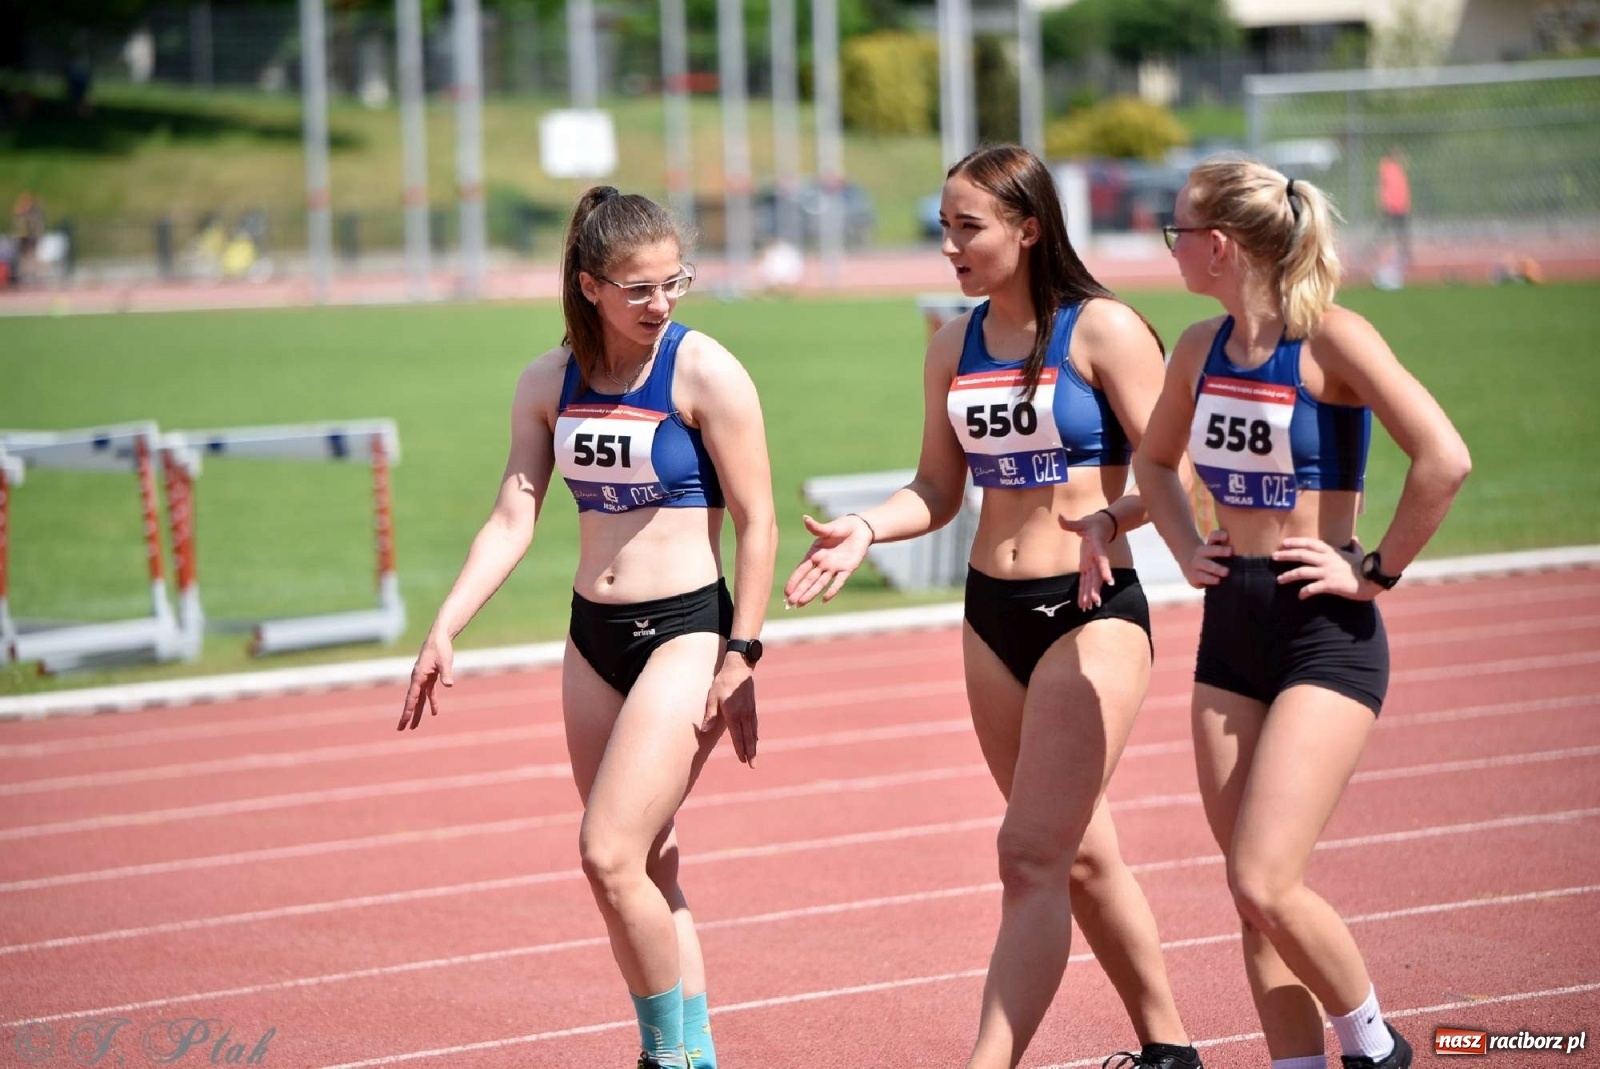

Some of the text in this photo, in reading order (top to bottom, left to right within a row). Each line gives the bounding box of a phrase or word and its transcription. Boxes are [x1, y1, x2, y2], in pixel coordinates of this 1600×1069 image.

[966, 401, 1038, 439] 550
[1204, 413, 1273, 456] 558
[573, 433, 632, 468] 551
[1032, 452, 1062, 483] CZE
[630, 485, 662, 505] CZE
[1262, 475, 1291, 507] CZE
